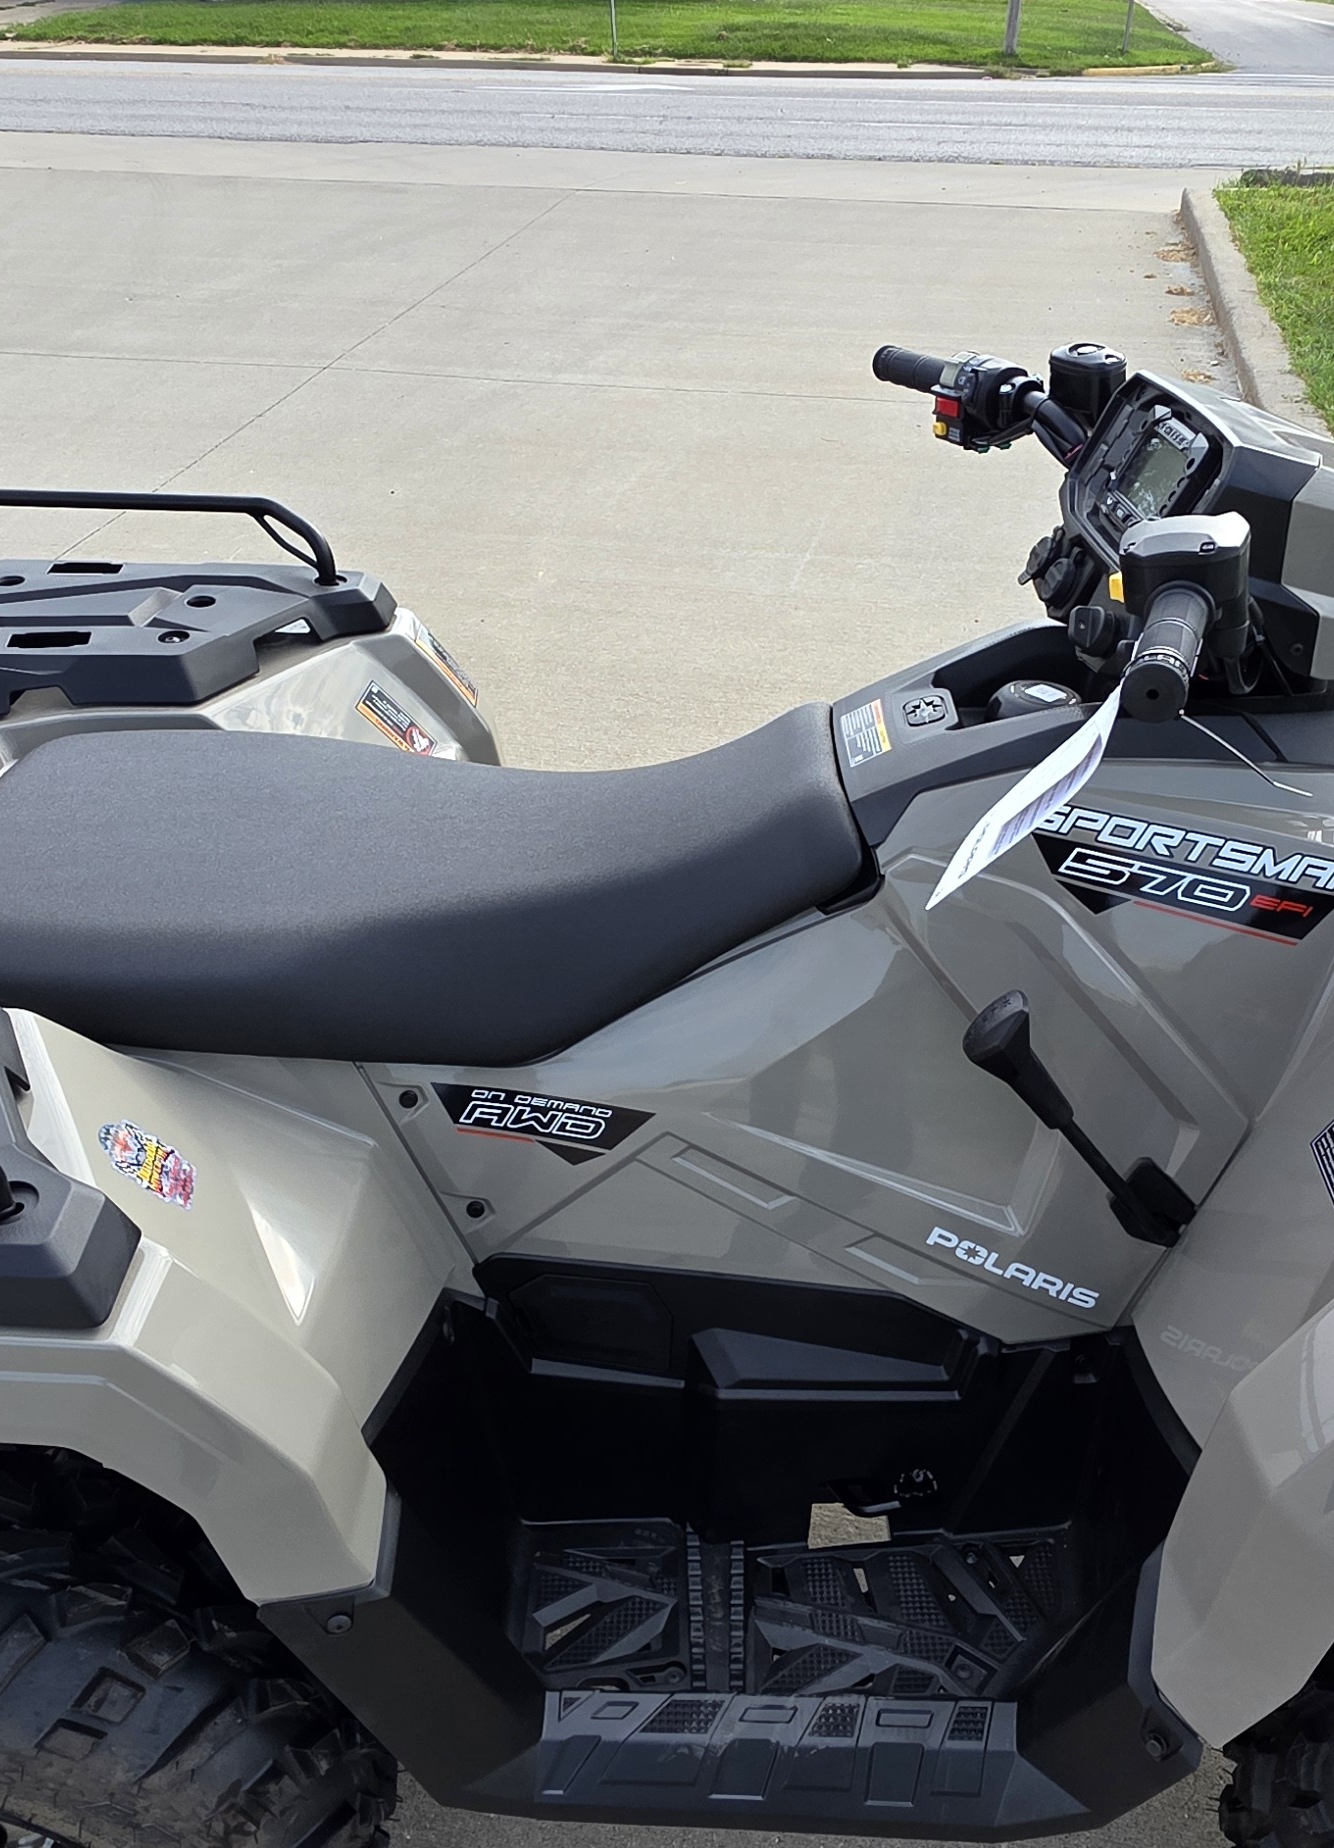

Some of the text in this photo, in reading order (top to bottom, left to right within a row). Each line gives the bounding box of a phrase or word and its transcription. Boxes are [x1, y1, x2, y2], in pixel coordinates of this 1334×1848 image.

[1058, 848, 1313, 917] 570 EFI
[459, 1101, 606, 1139] AWD
[514, 1095, 612, 1118] DEMAND
[925, 1226, 1100, 1309] POLARIS
